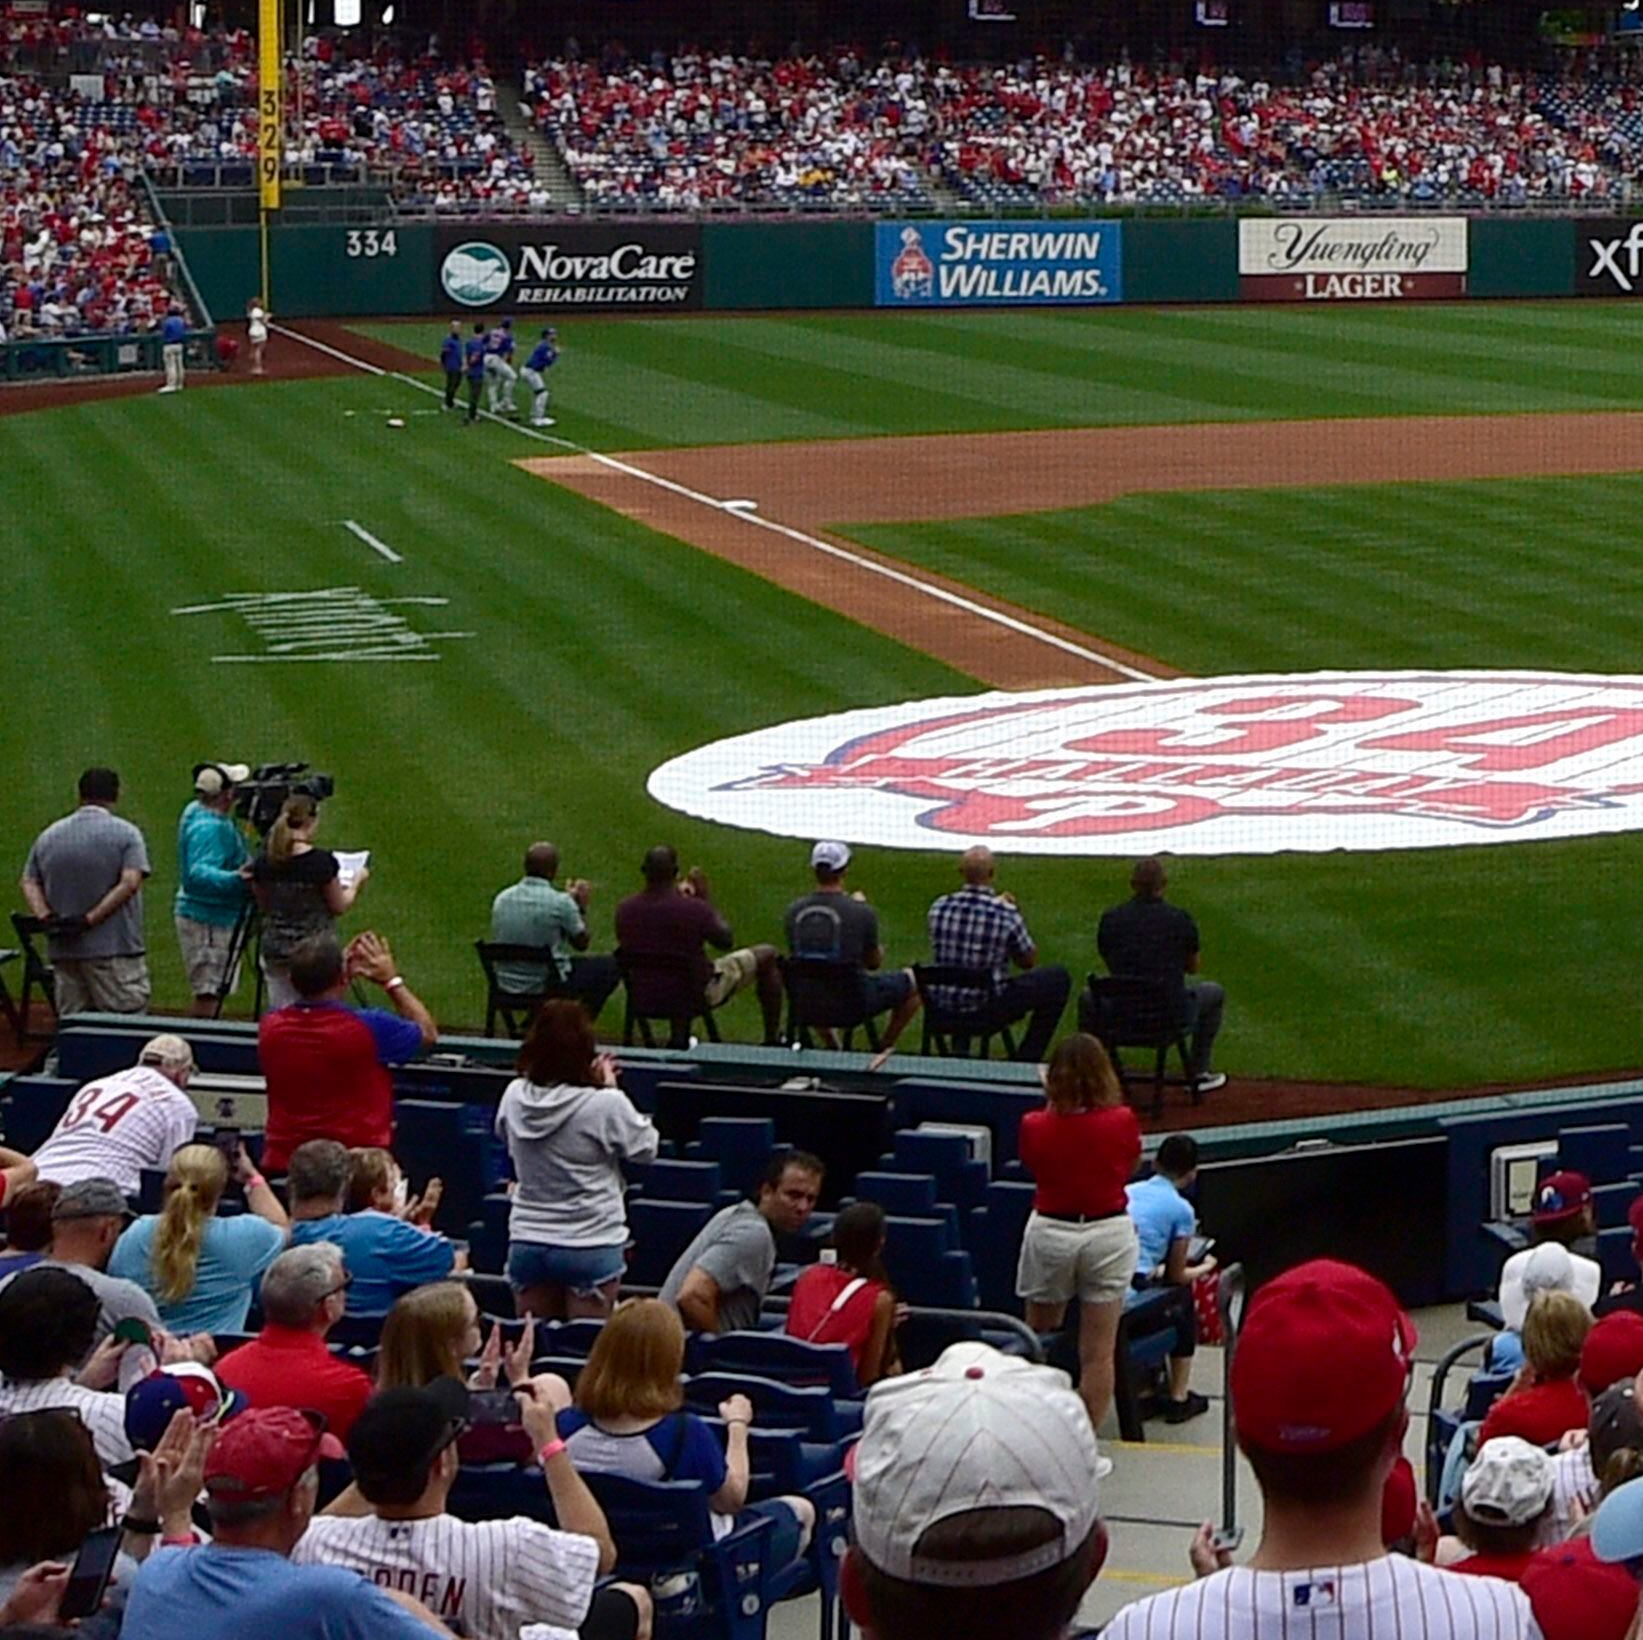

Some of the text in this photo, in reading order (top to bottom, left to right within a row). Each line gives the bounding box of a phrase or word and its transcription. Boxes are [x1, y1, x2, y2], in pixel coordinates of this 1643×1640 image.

[346, 230, 397, 257] 334
[942, 227, 1100, 262] SHERWIN
[1268, 222, 1438, 272] Yuengling
[515, 245, 696, 281] NovaCare
[515, 286, 689, 304] REHABILITATION
[1305, 273, 1403, 300] LAGER
[62, 1086, 141, 1135] 34
